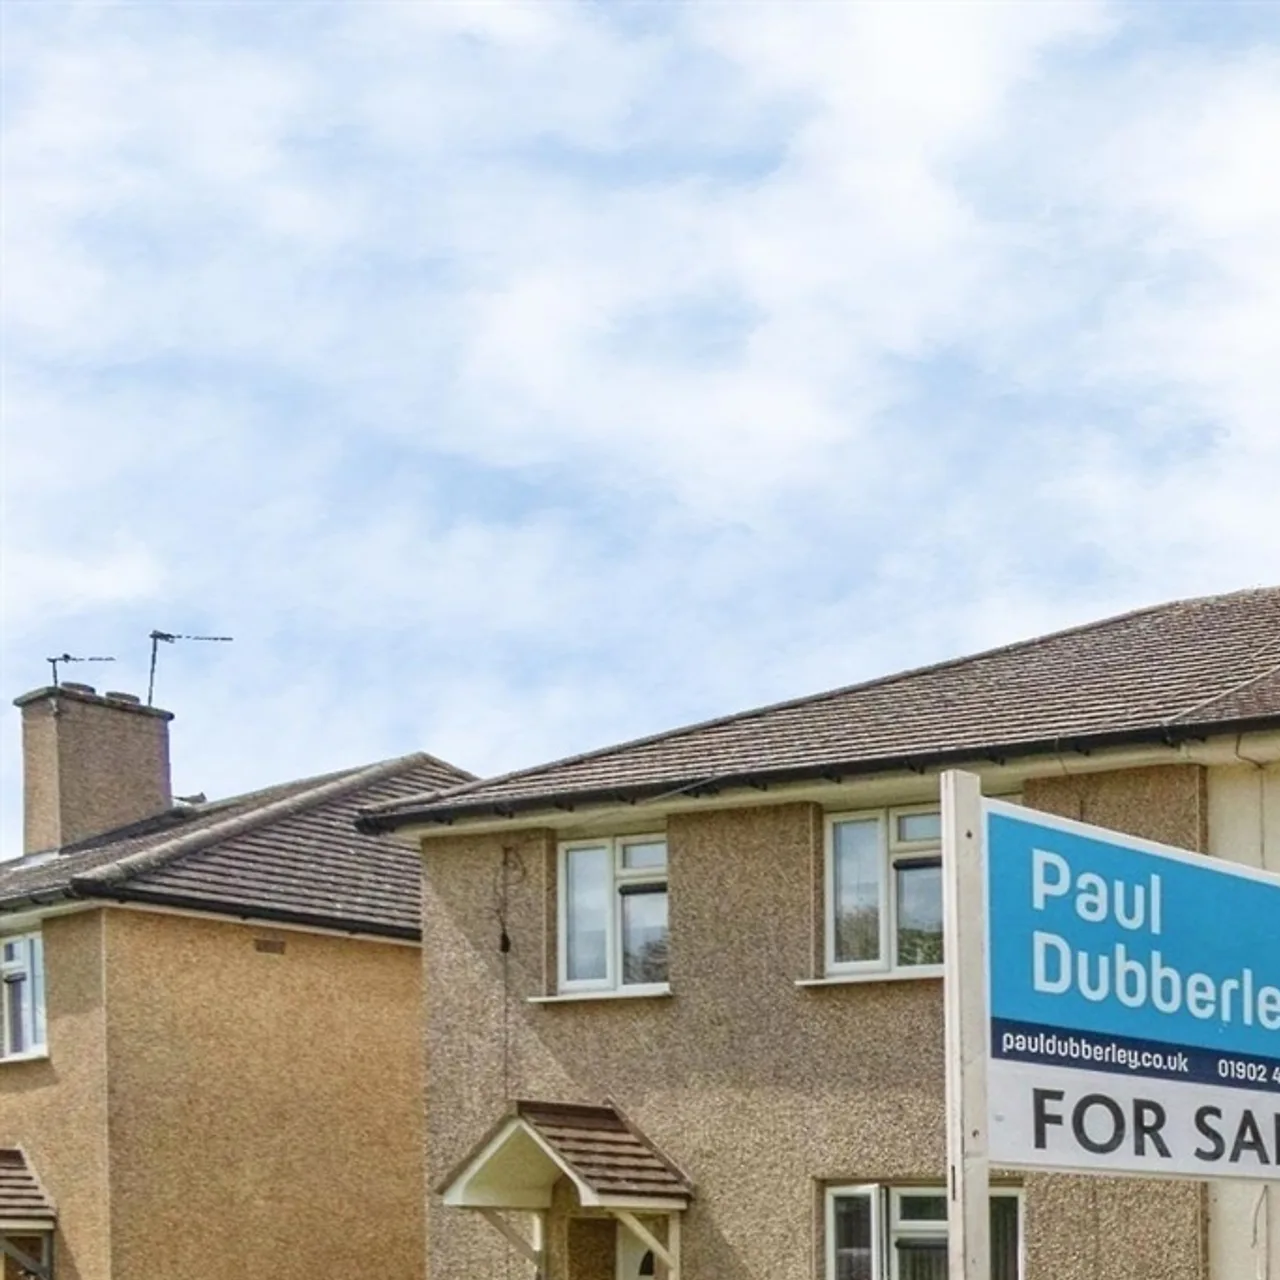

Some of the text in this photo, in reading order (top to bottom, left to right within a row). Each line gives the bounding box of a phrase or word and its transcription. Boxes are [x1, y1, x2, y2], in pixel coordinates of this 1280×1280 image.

[1032, 848, 1161, 934] Paul
[1002, 1032, 1189, 1073] pauldubberley.co.uk
[1218, 1058, 1267, 1082] 01902
[1032, 1088, 1172, 1158] FOR
